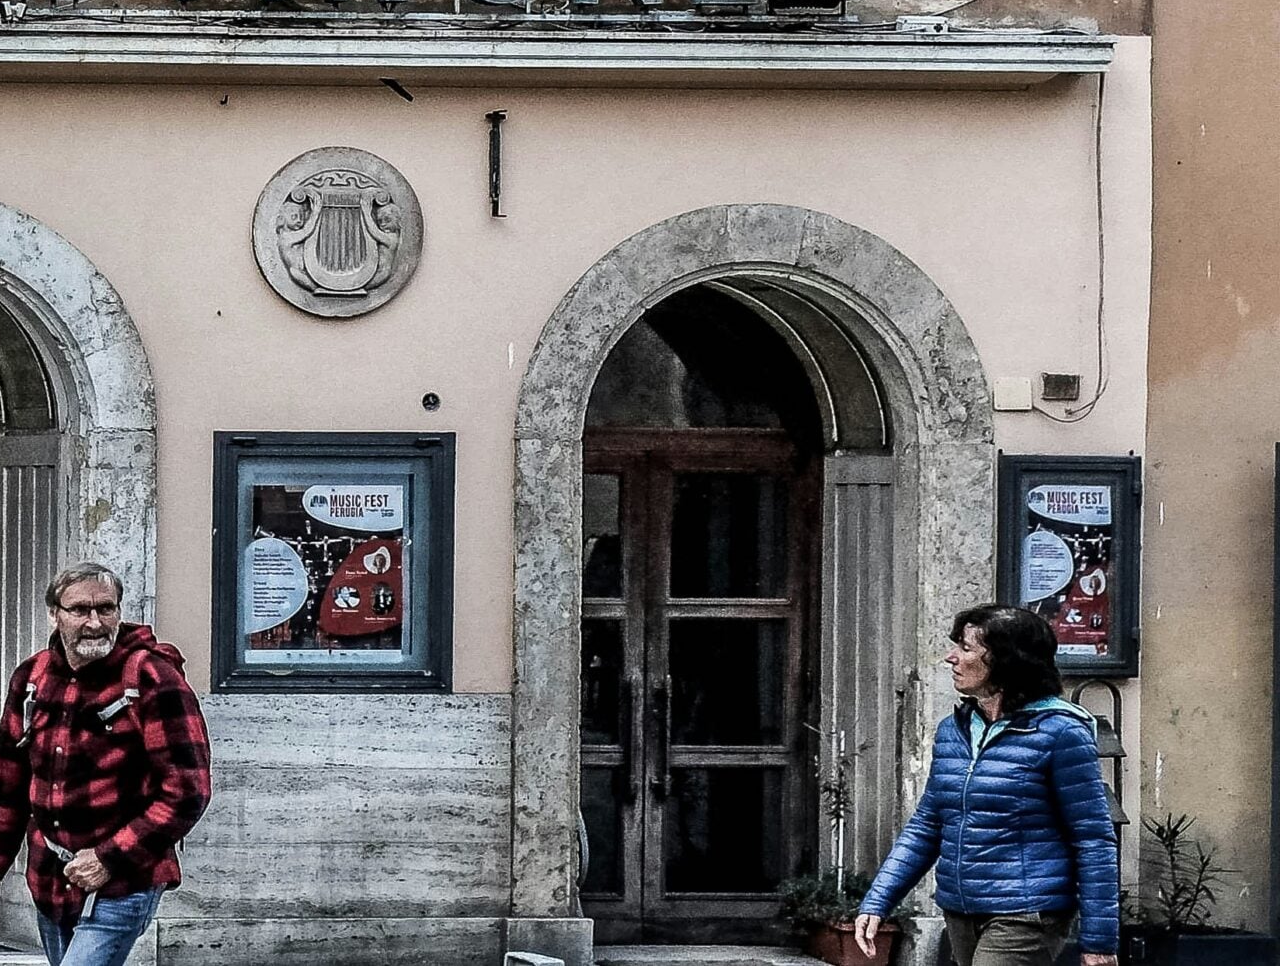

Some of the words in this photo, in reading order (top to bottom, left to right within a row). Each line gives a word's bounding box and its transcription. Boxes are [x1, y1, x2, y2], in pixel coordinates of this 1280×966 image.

[329, 494, 362, 507] MUSIC
[364, 494, 389, 508] FEST
[1046, 491, 1077, 504] MUSIC
[1080, 491, 1103, 505] FEST
[329, 507, 364, 517] PERUGIA
